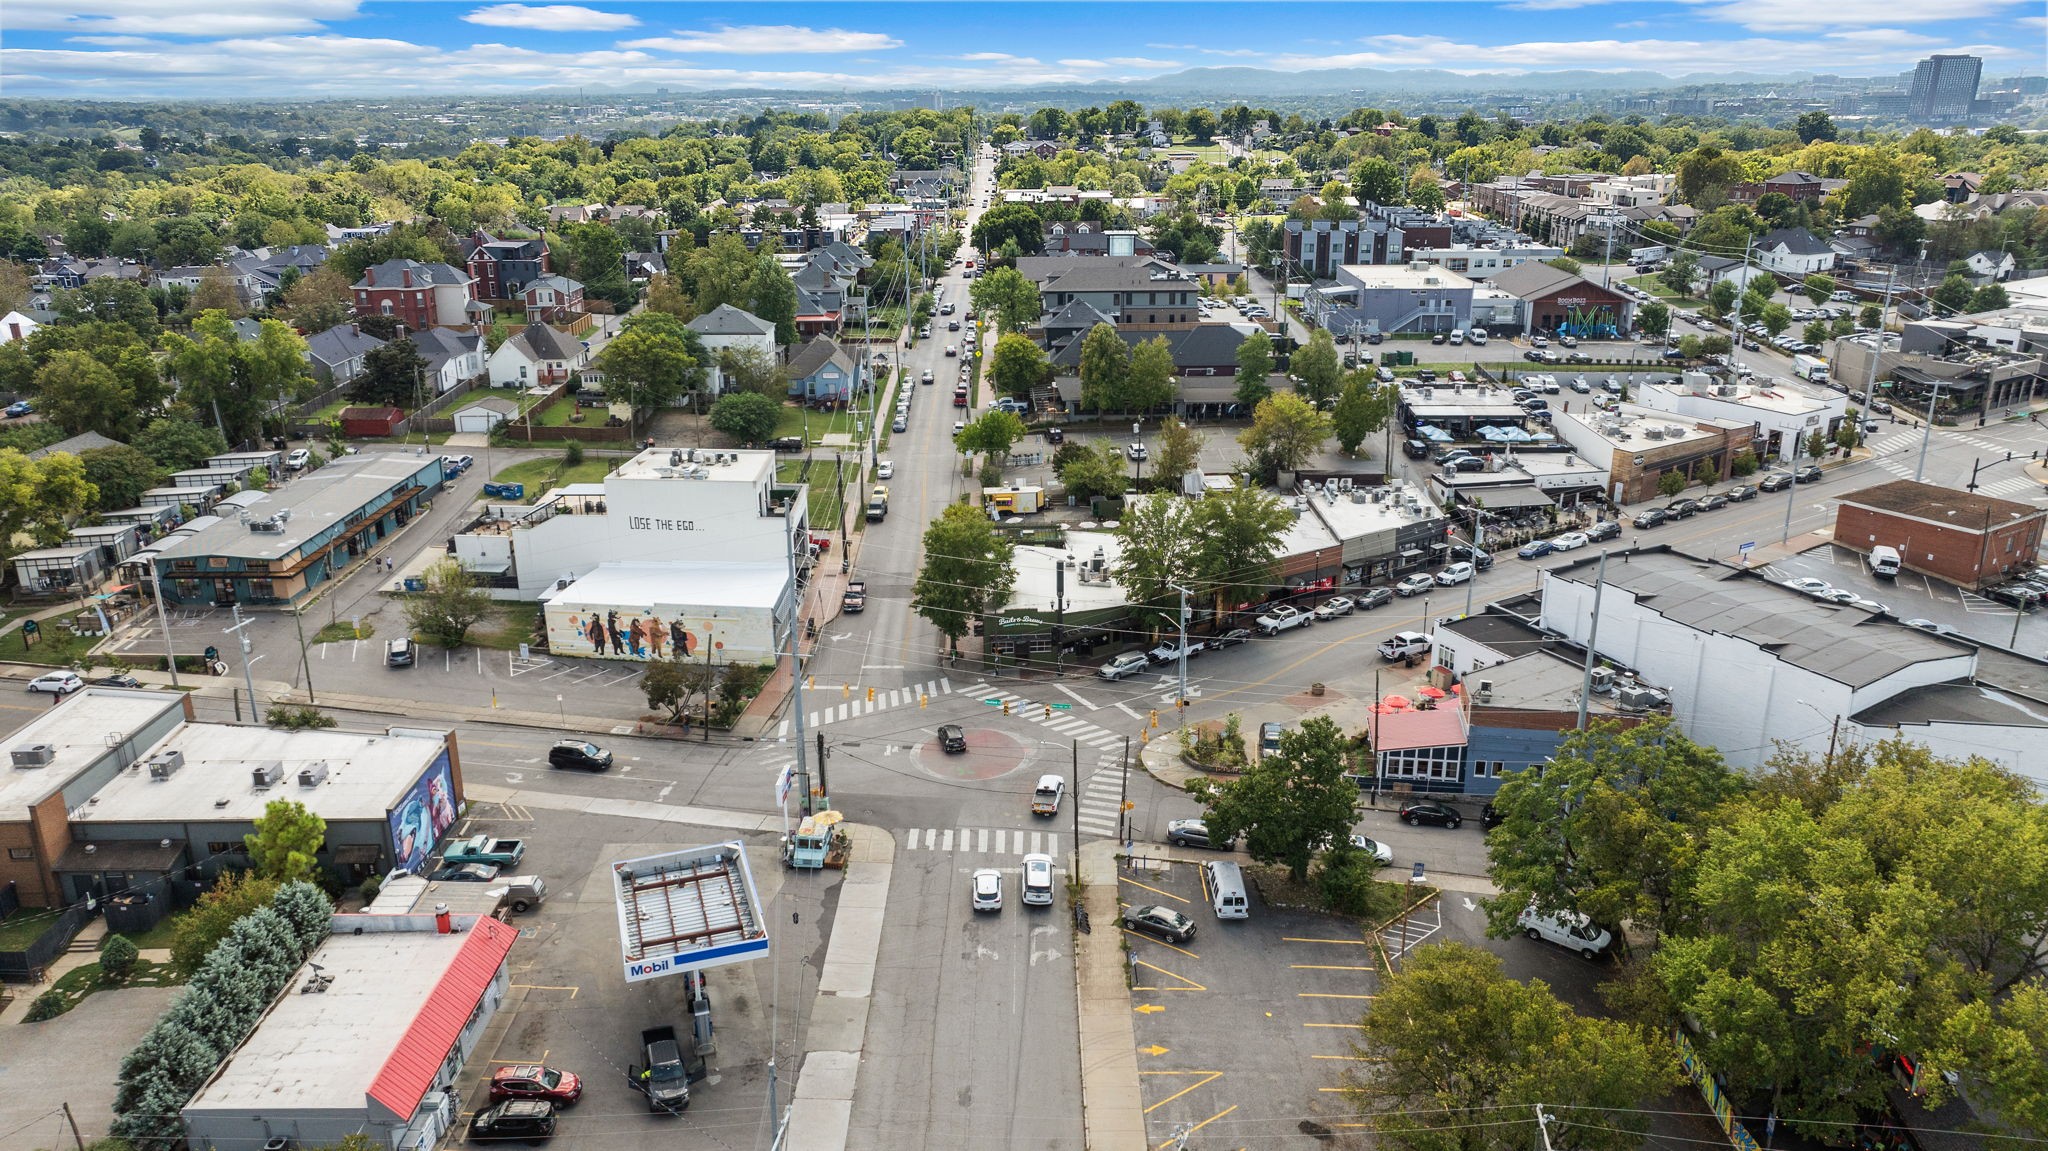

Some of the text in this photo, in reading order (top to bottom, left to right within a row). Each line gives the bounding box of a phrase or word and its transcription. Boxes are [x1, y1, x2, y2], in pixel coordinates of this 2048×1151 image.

[629, 516, 651, 530] LOSE
[655, 518, 673, 531] THE
[630, 960, 669, 976] Mobil
